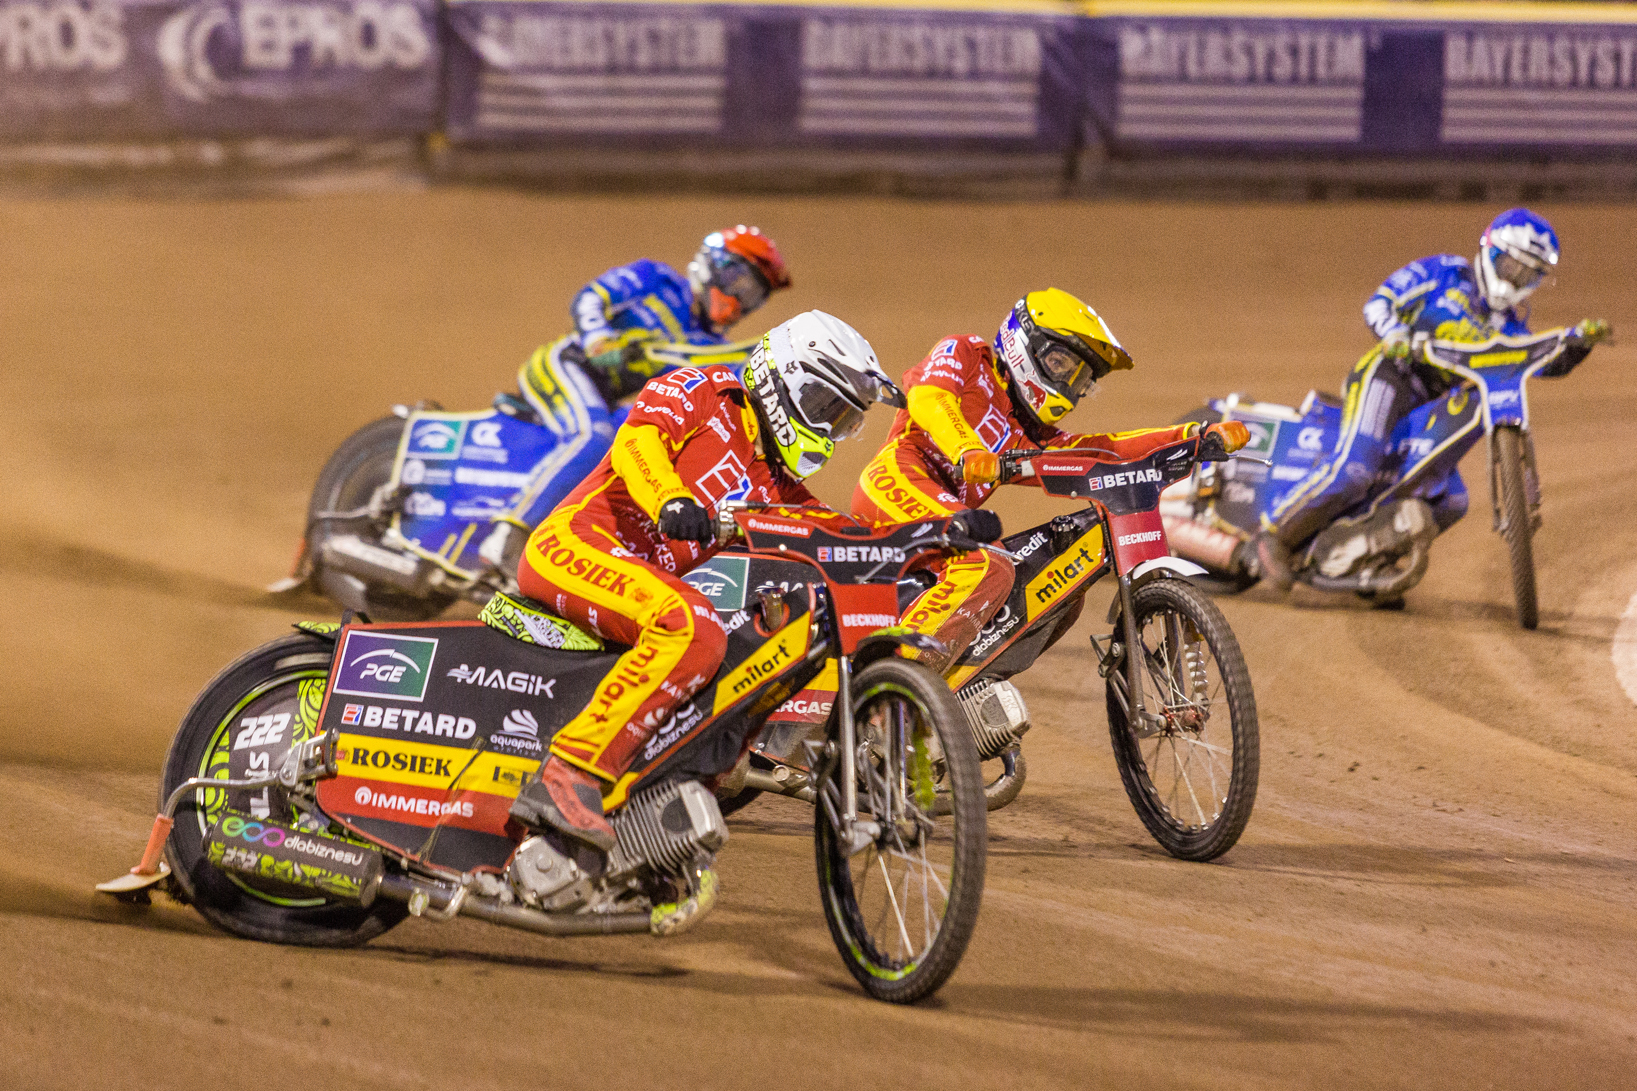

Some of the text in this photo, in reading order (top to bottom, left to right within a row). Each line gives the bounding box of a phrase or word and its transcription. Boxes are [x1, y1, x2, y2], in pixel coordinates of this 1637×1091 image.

[1004, 338, 1025, 368] Bull
[750, 348, 797, 446] BETARD
[630, 446, 663, 493] IMMERGAS
[1103, 469, 1163, 489] BETARD
[868, 464, 934, 520] ROSIE
[756, 521, 809, 536] IMMERGAS
[1118, 531, 1162, 546] BECKHOFF
[536, 534, 635, 597] ROSIEK
[833, 547, 905, 563] BETARD
[1035, 546, 1094, 603] milart
[842, 613, 897, 627] BECKHOFF
[359, 663, 407, 683] PGE
[733, 645, 790, 693] milart
[590, 646, 659, 723] milart
[364, 705, 477, 740] BETARD
[774, 700, 833, 716] RGAS
[233, 712, 292, 750] 222
[490, 734, 542, 752] aquapark
[351, 747, 452, 777] ROSIEK
[372, 792, 474, 817] IMMERGAS
